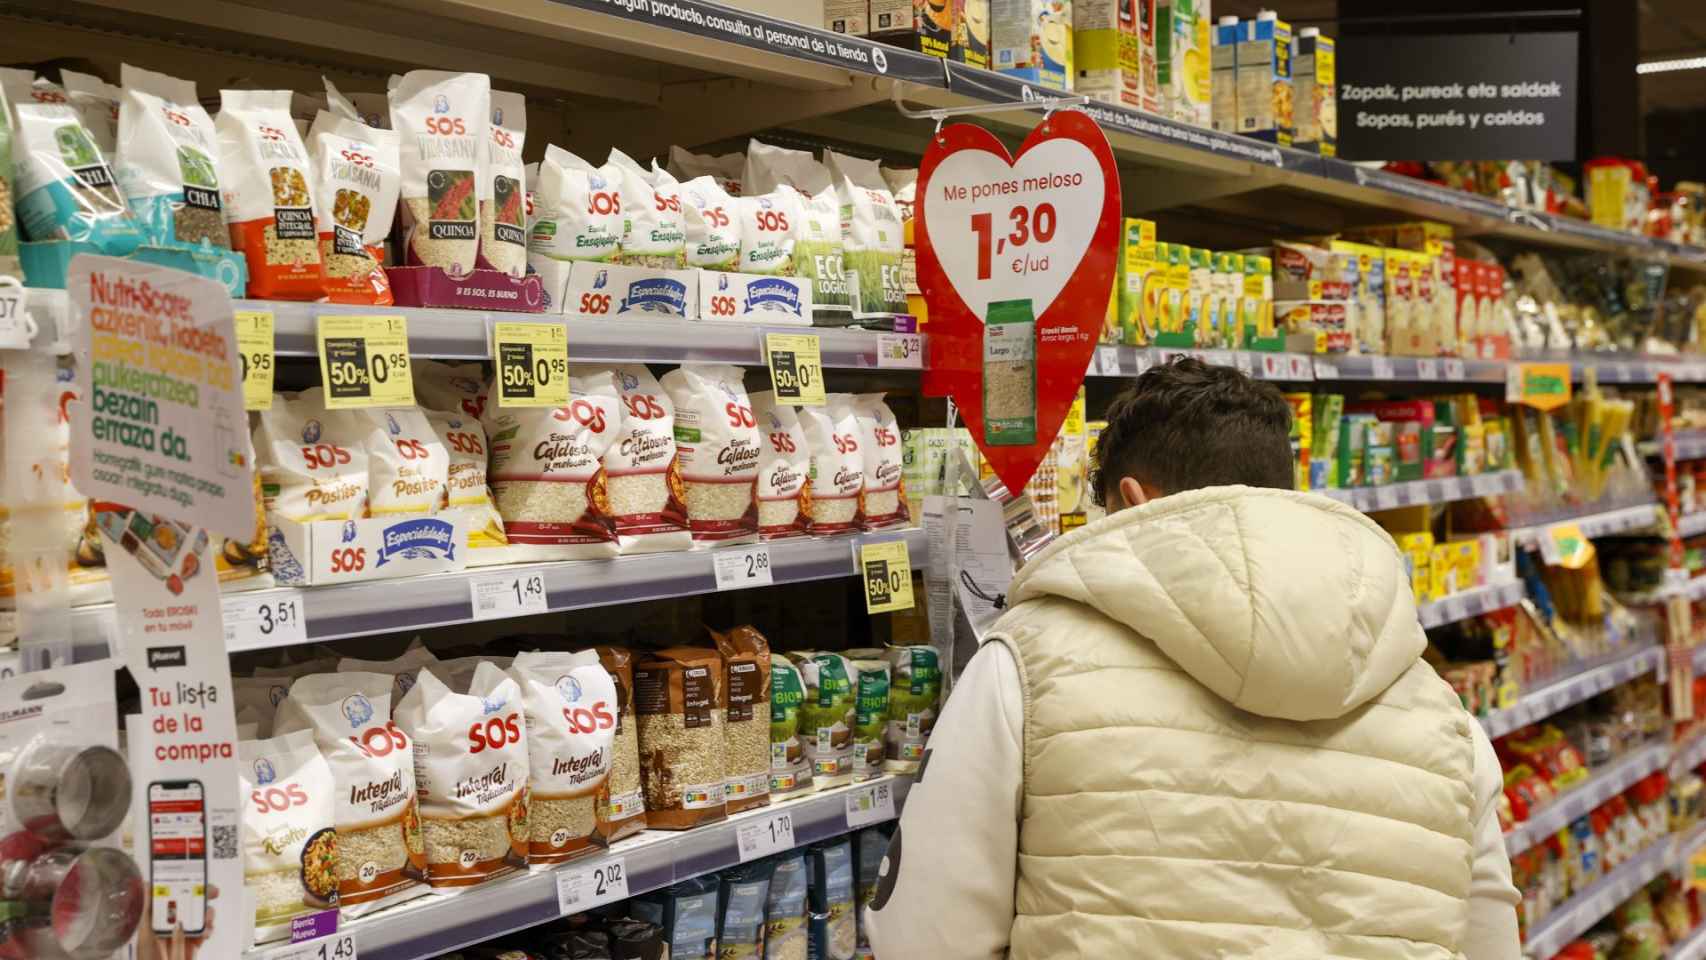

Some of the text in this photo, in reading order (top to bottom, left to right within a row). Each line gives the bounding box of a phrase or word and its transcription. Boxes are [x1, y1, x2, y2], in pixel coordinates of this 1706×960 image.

[651, 1, 706, 26] producto,
[706, 15, 751, 37] consulta
[753, 25, 764, 40] al
[765, 29, 810, 50] personal
[811, 38, 825, 53] de
[826, 41, 837, 56] la
[838, 44, 869, 63] tienda
[1341, 81, 1562, 102] Zopak, pureak eta saldak
[425, 117, 466, 136] SOS
[1356, 109, 1545, 130] Sopas, purés y caldos
[944, 172, 1083, 203] Me pones meloso
[187, 190, 220, 209] CHIA
[703, 206, 730, 228] OS
[755, 211, 789, 232] SOS
[432, 224, 475, 237] QUINOA
[970, 202, 1058, 281] 1,30
[1011, 253, 1050, 276] €/ud
[579, 293, 612, 314] SOS
[711, 296, 736, 316] SOS
[330, 361, 369, 385] 50%
[371, 353, 407, 384] 0,95
[503, 365, 534, 386] 50%
[536, 358, 566, 386] 0,95
[775, 370, 799, 388] 50%
[91, 382, 159, 425] bezain
[91, 415, 192, 463] erraza da.
[394, 439, 429, 460] OS
[447, 432, 483, 455] SOS
[768, 431, 797, 453] SOS
[302, 443, 352, 470] SOS
[386, 525, 451, 545] Especialidades
[331, 547, 367, 573] SOS
[745, 552, 769, 577] 2,68
[513, 576, 542, 605] 1,43
[869, 578, 890, 596] 50%
[258, 601, 296, 635] 3,51
[149, 681, 217, 709] Tu lista
[775, 692, 795, 705] BIO
[153, 713, 203, 733] de la
[563, 701, 614, 734] SOS
[468, 712, 520, 754] SOS
[155, 742, 233, 764] compra
[552, 747, 604, 776] Integral
[350, 768, 403, 805] Integral
[456, 762, 508, 798] Integral
[251, 783, 309, 814] SOS
[554, 832, 565, 843] 20
[768, 815, 791, 844] 1,70
[462, 852, 475, 863] 20
[363, 866, 374, 877] 20
[593, 863, 622, 896] 2,02
[293, 916, 315, 930] Berria
[293, 928, 316, 941] Nuevo
